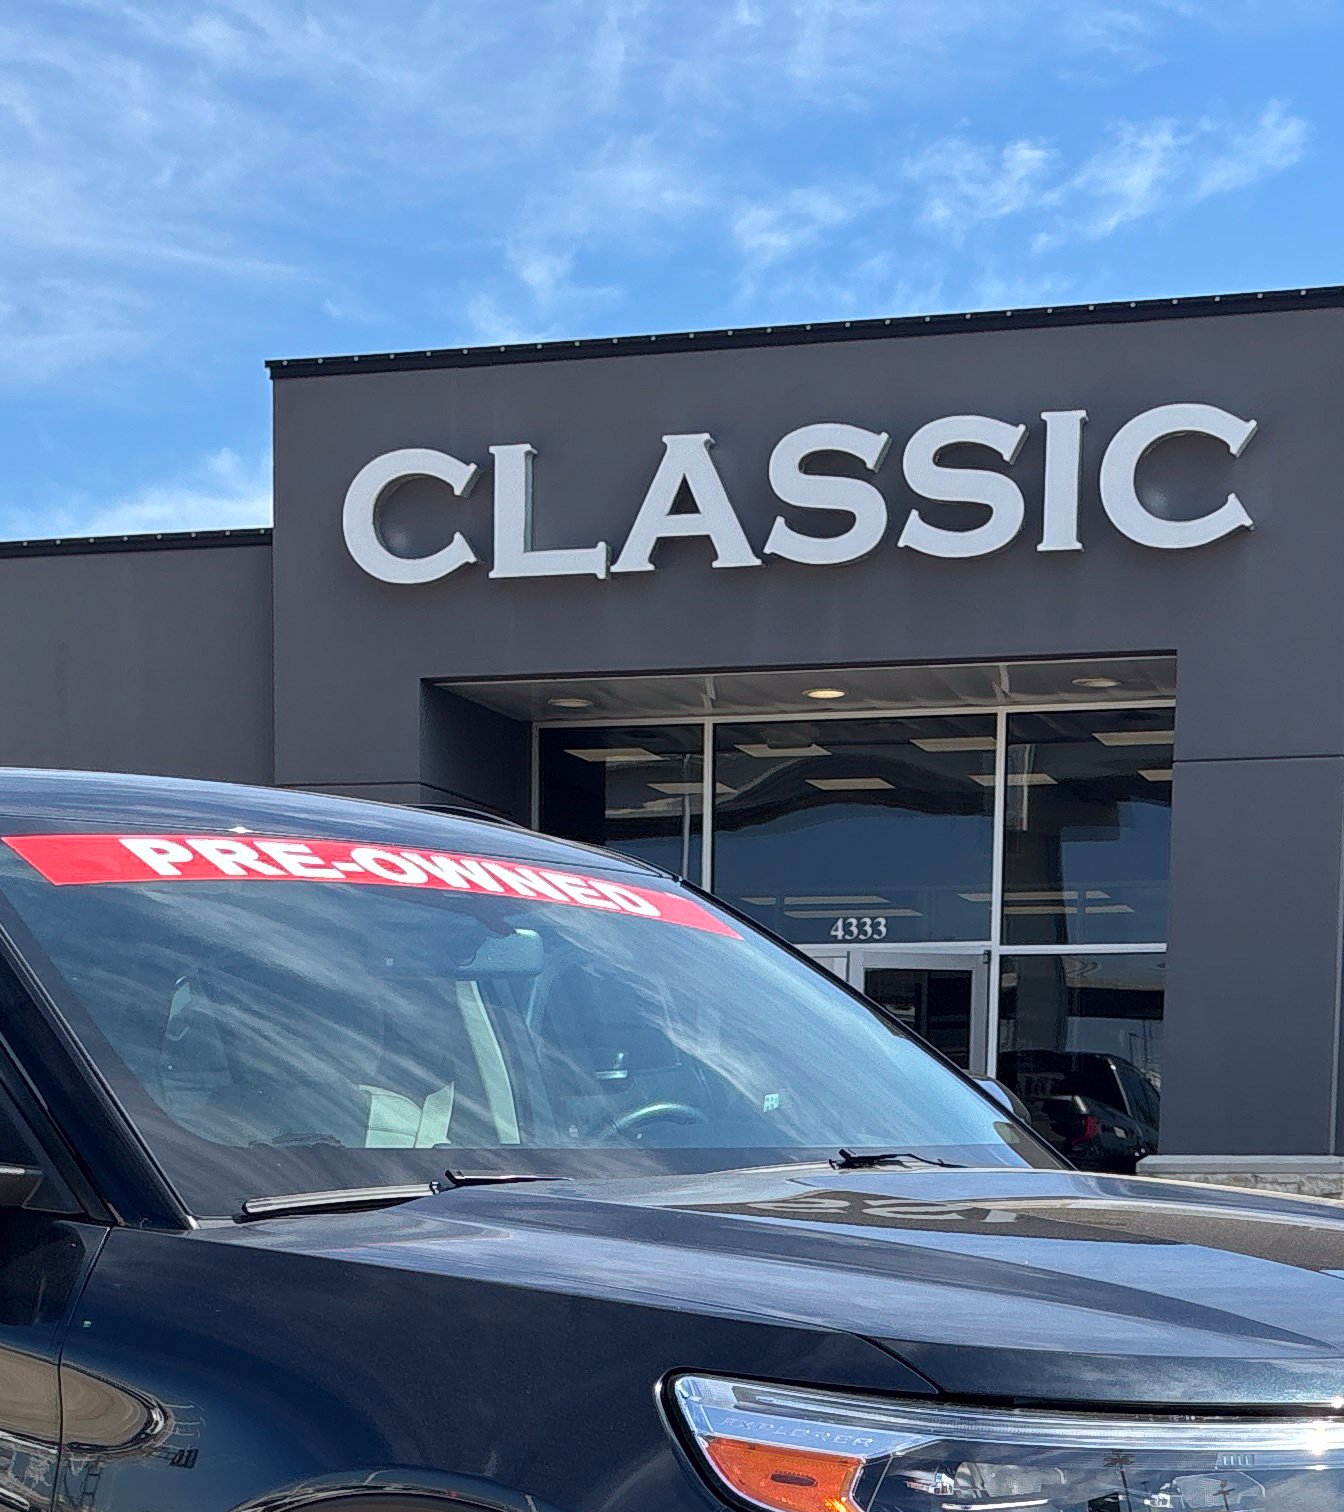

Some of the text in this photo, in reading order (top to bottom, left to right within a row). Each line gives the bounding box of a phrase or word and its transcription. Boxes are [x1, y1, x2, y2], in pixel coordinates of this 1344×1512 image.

[342, 402, 1259, 585] CLASSIC
[118, 836, 662, 917] PRE-OWNED
[830, 917, 887, 940] 4333
